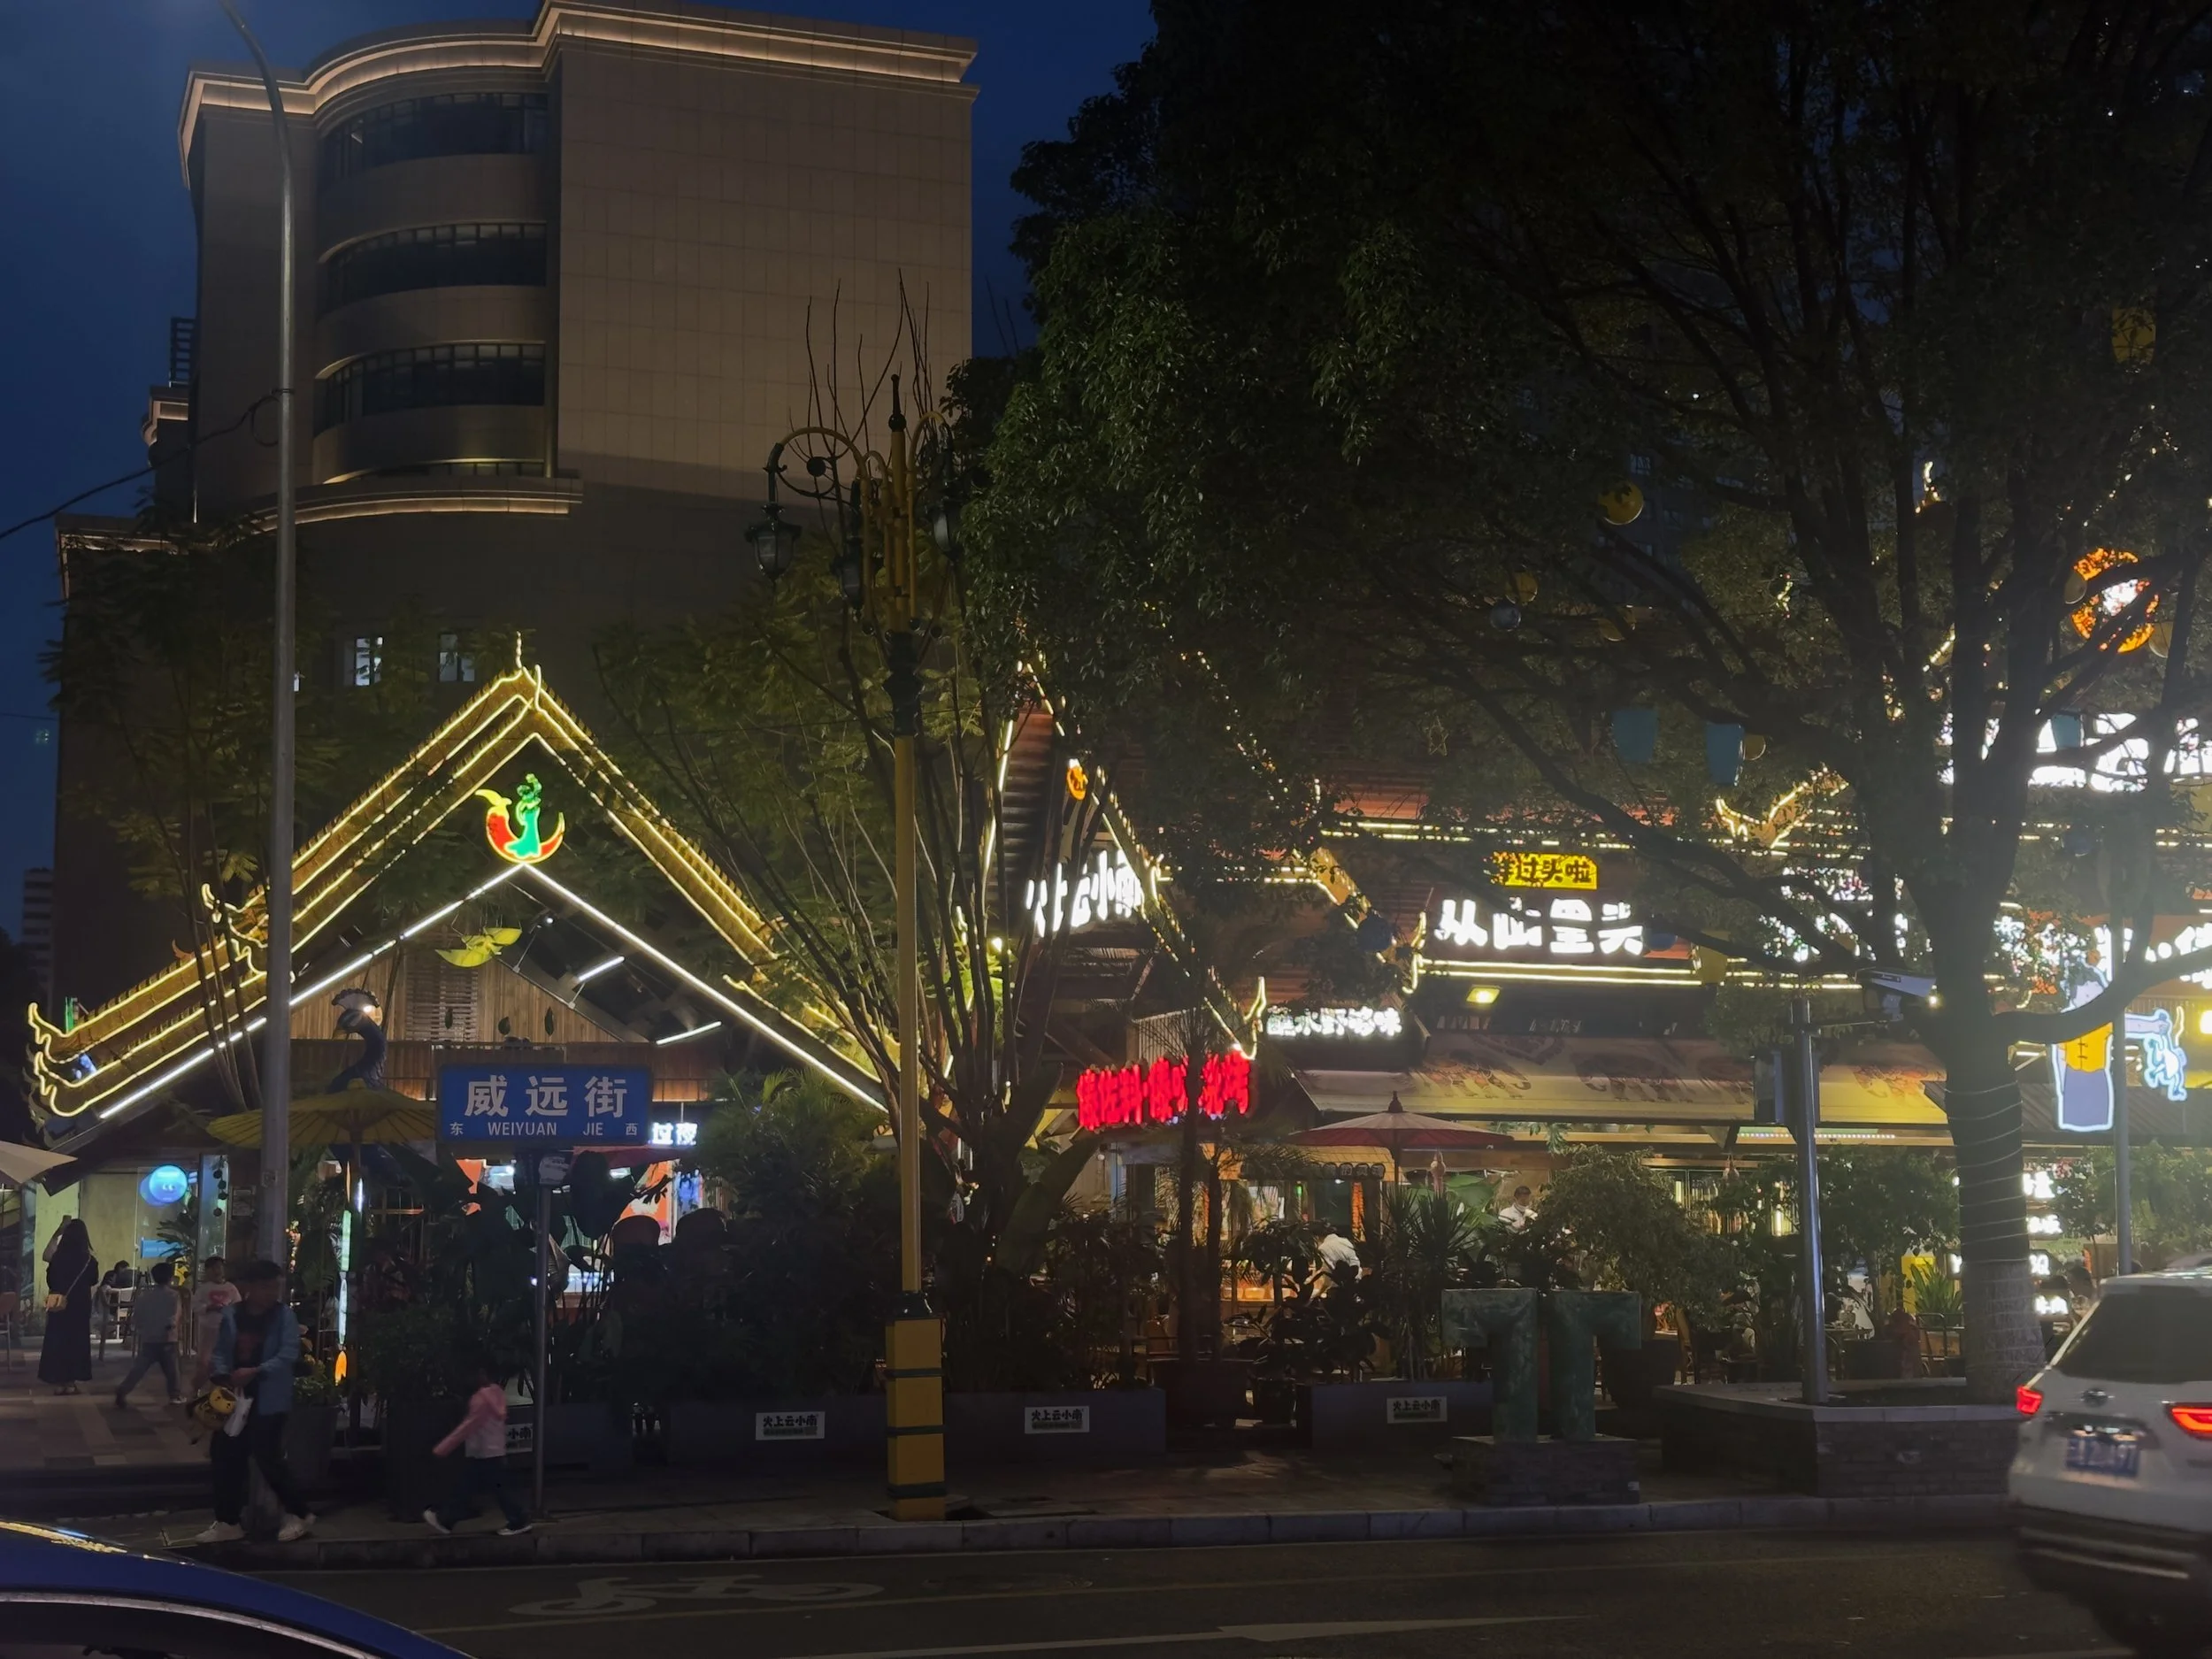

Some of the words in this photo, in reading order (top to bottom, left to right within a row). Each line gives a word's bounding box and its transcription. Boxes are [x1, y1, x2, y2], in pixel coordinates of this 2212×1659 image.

[465, 1074, 627, 1118] 威远街
[449, 1122, 464, 1135] 东
[488, 1122, 557, 1136] WEIYUAN
[582, 1122, 603, 1136] JIE
[626, 1123, 638, 1136] 西
